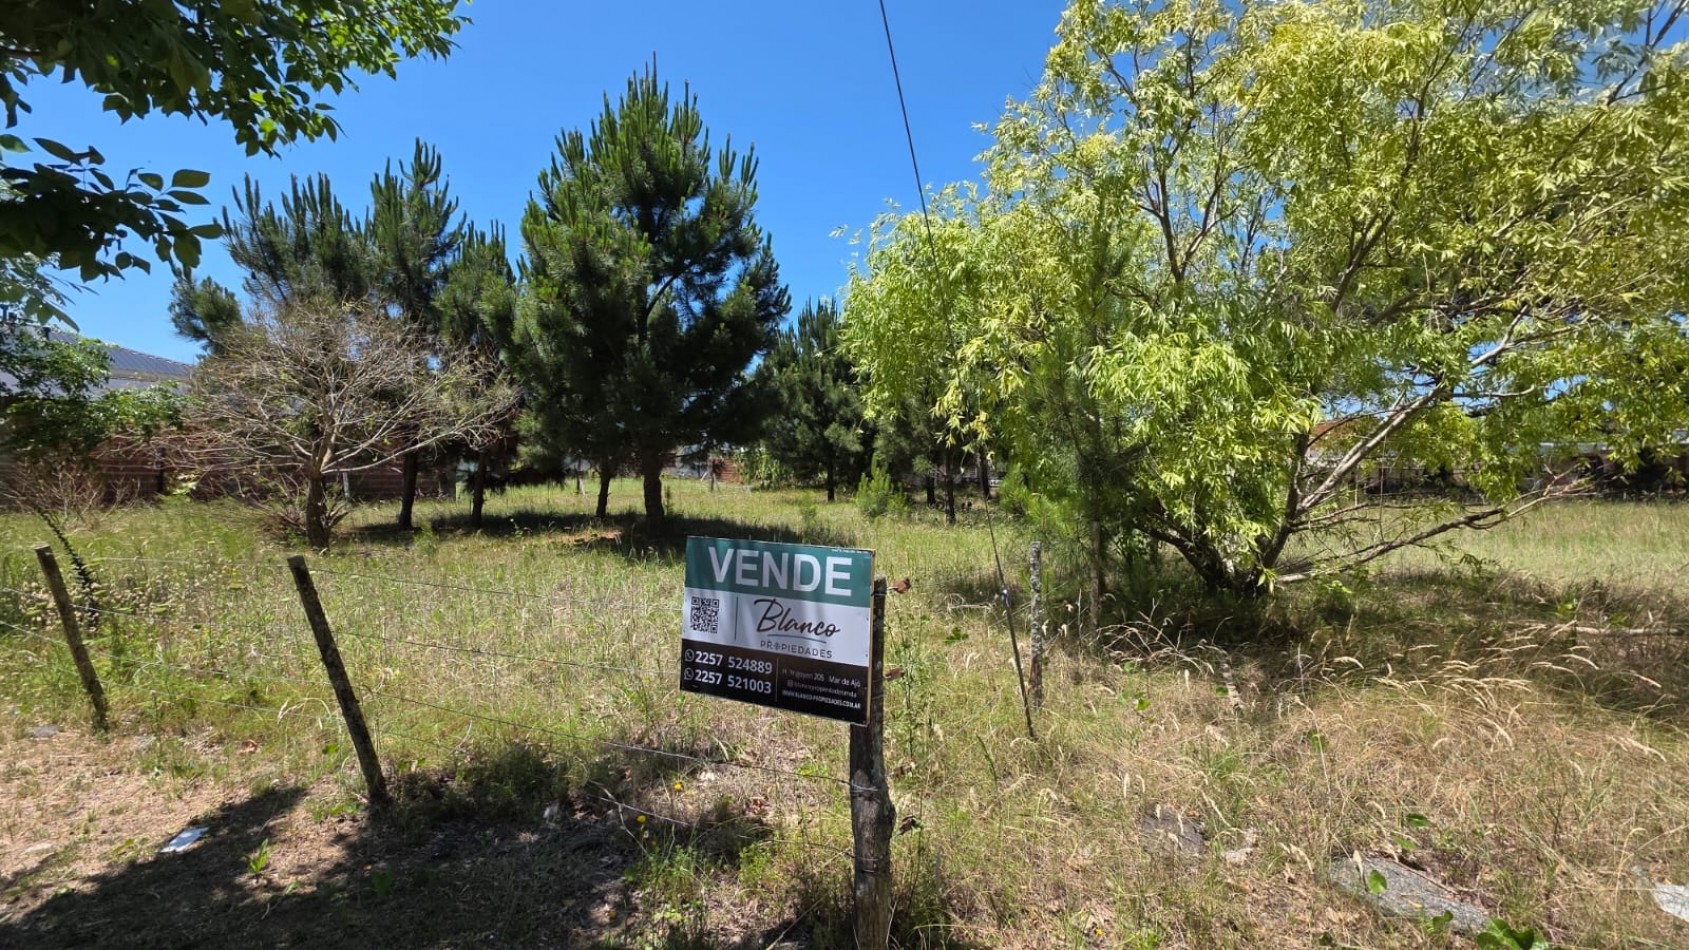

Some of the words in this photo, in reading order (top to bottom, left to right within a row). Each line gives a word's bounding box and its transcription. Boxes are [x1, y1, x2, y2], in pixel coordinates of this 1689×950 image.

[708, 546, 852, 597] VENDE
[753, 598, 840, 637] Blanco
[760, 640, 833, 659] PROPIEDADES
[695, 650, 723, 666] 2257
[728, 656, 773, 674] 524889
[695, 669, 723, 685] 2257
[727, 675, 772, 694] 521003
[829, 675, 841, 684] Mar
